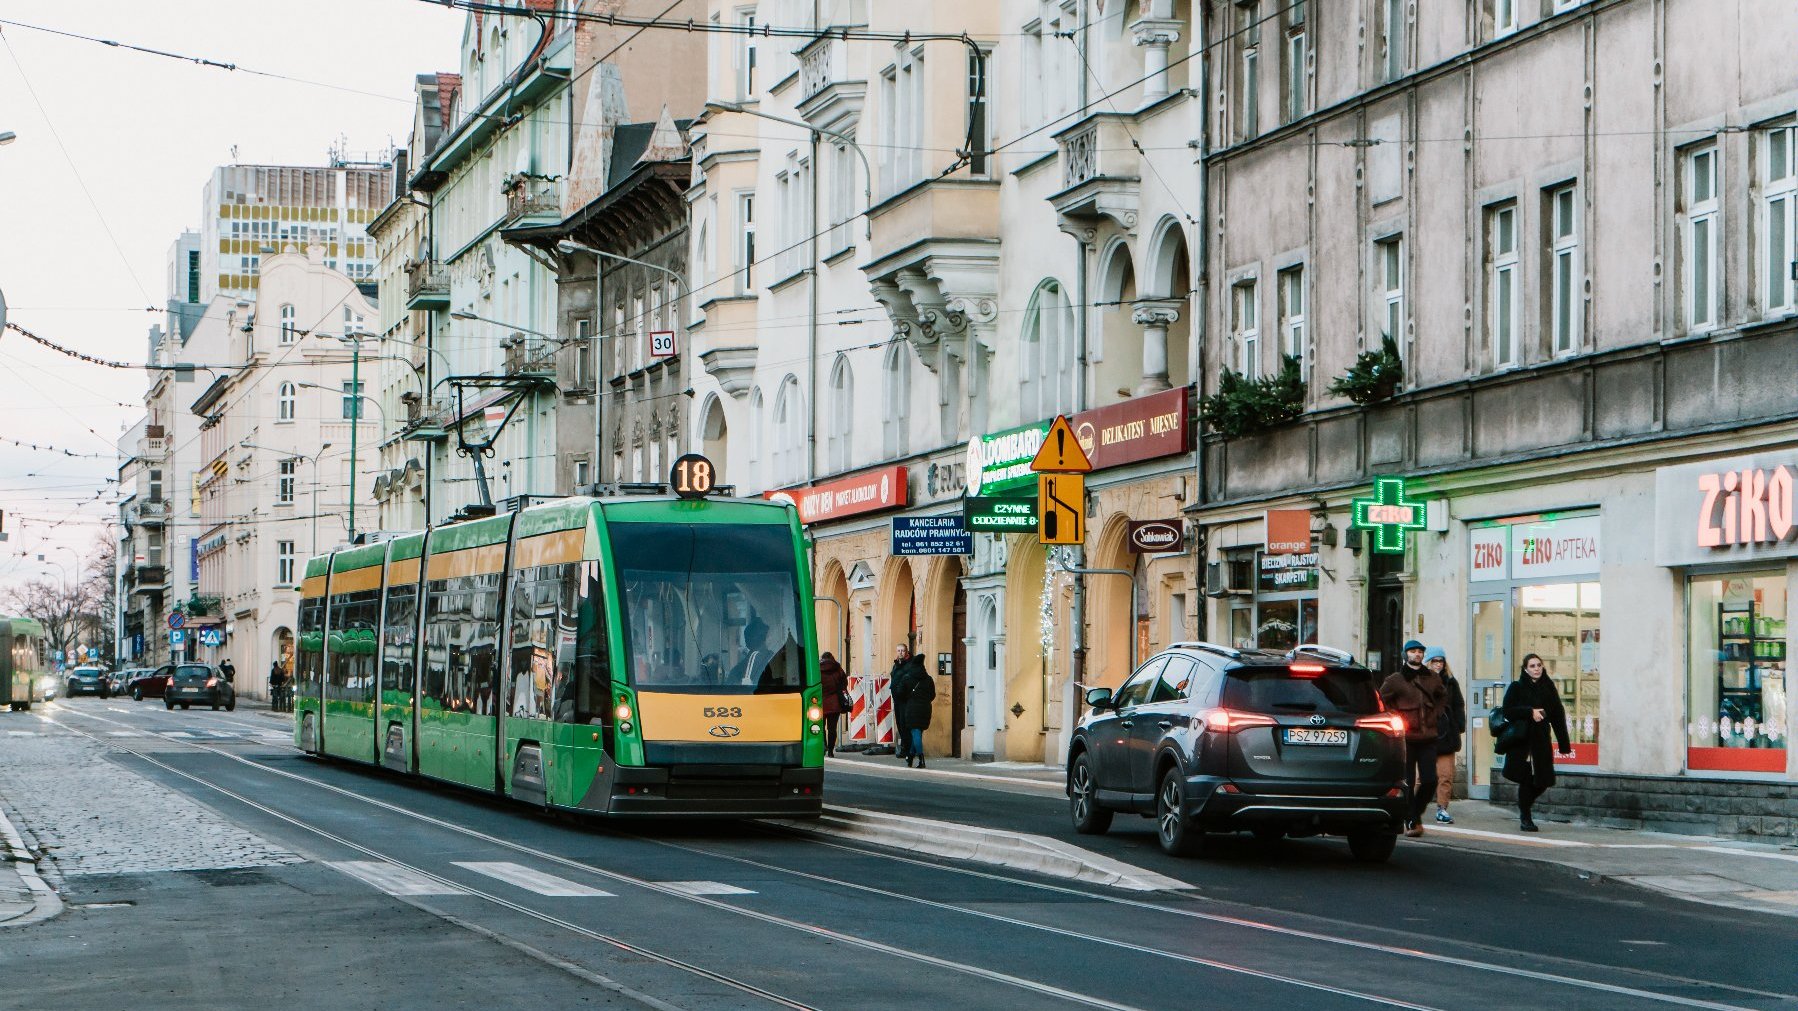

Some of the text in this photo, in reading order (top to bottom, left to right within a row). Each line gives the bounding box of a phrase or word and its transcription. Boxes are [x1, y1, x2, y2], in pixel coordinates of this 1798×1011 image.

[654, 338, 671, 350] 30
[1101, 420, 1146, 446] DELIKATESY
[678, 460, 710, 492] 18
[994, 504, 1031, 514] CZYNNE
[909, 518, 955, 527] KANCELARIA
[972, 516, 1028, 525] CODZIENNIE
[894, 528, 927, 539] RADCÓW
[1140, 528, 1174, 543] Sobkowiak
[1269, 541, 1306, 551] orange
[1554, 536, 1597, 561] APTEKA
[1275, 570, 1308, 585] SKARPETKI
[703, 706, 743, 718] 523
[1289, 730, 1311, 742] PSZ
[1313, 731, 1346, 743] 97259
